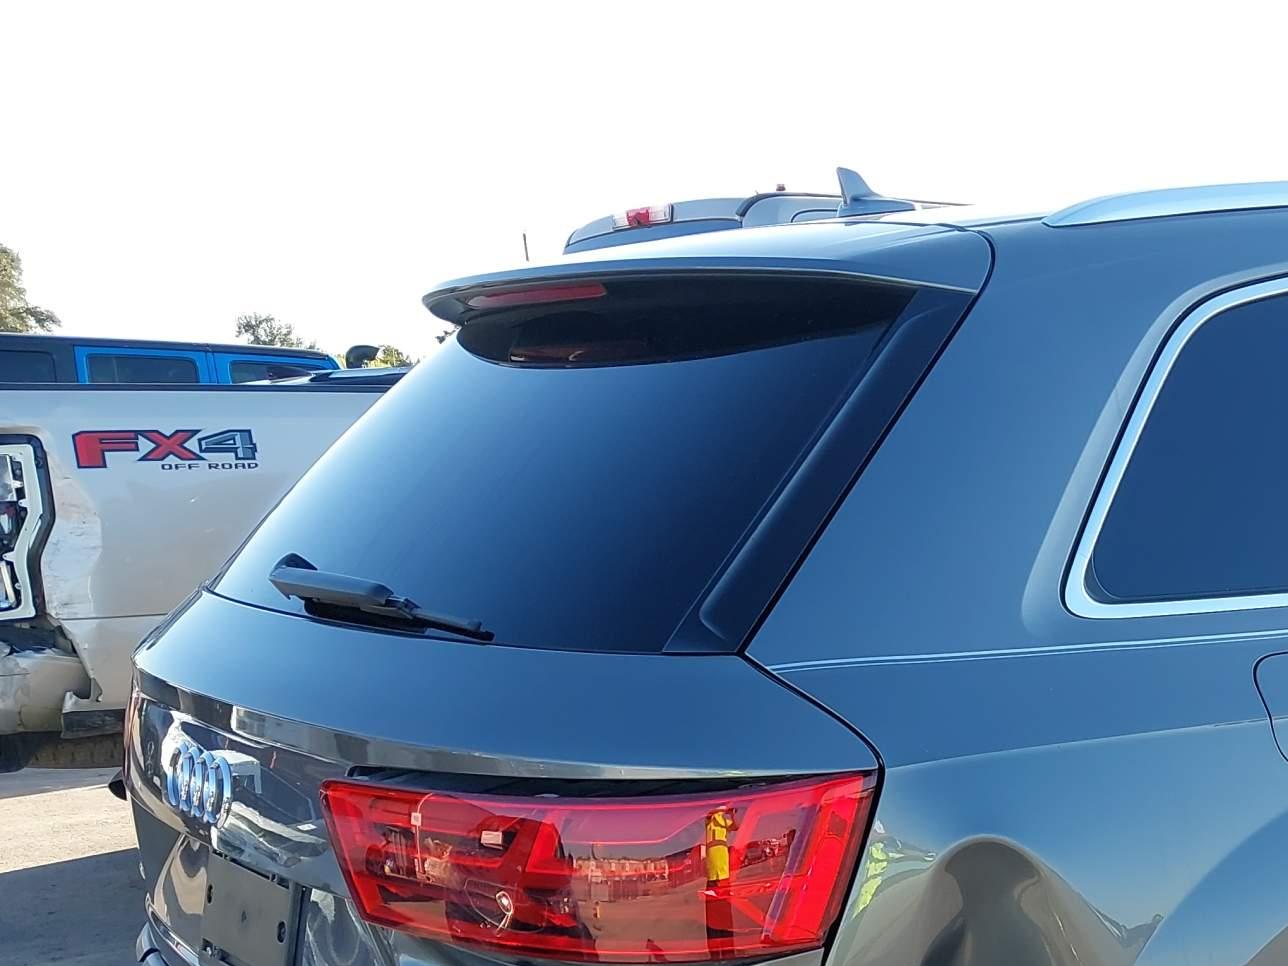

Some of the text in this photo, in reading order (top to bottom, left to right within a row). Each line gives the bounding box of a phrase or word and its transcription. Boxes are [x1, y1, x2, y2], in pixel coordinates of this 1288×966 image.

[72, 429, 258, 469] FX4
[161, 462, 259, 471] OFF ROAD
